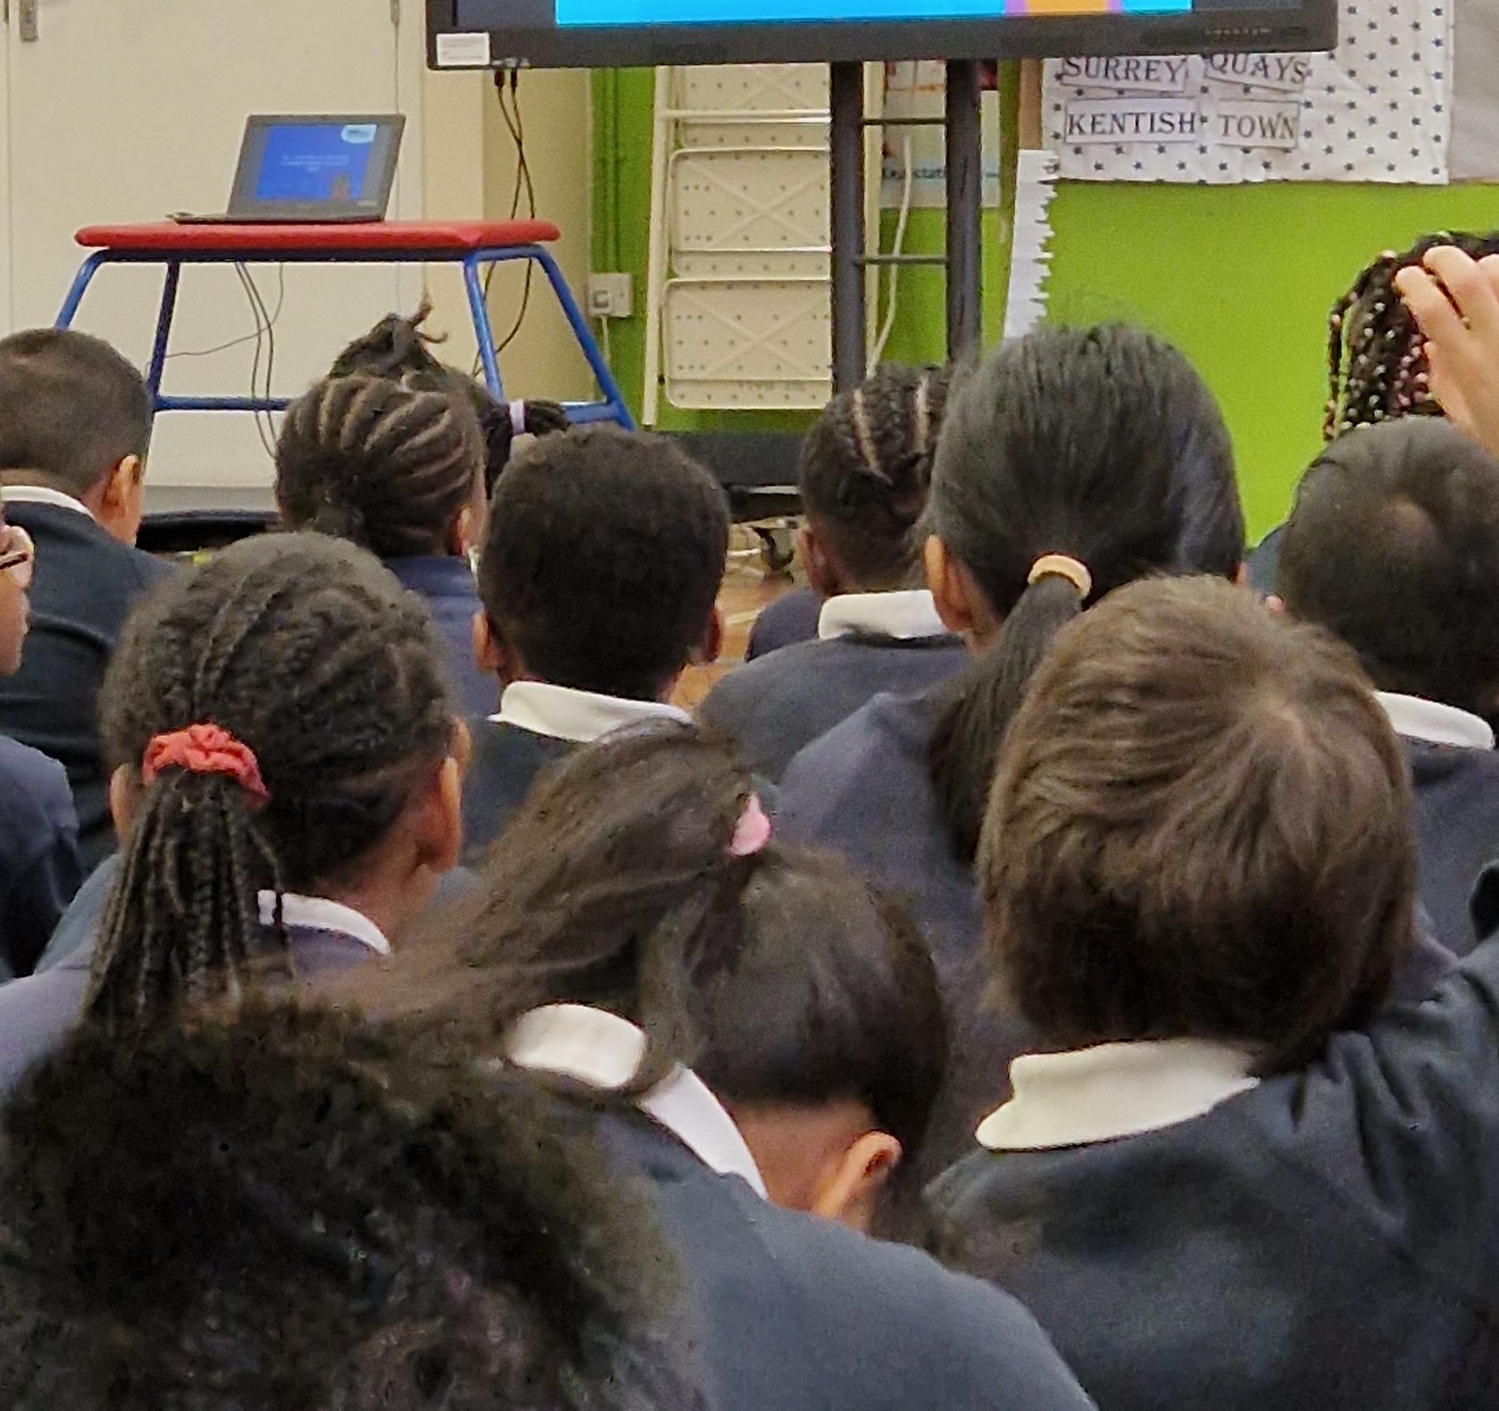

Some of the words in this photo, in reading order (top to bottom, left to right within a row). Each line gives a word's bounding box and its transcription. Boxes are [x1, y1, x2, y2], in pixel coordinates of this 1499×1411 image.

[1064, 55, 1188, 84] SURREY
[1209, 54, 1308, 85] QUAYS
[1067, 111, 1197, 136] KENTISH
[1217, 112, 1298, 139] TOWN
